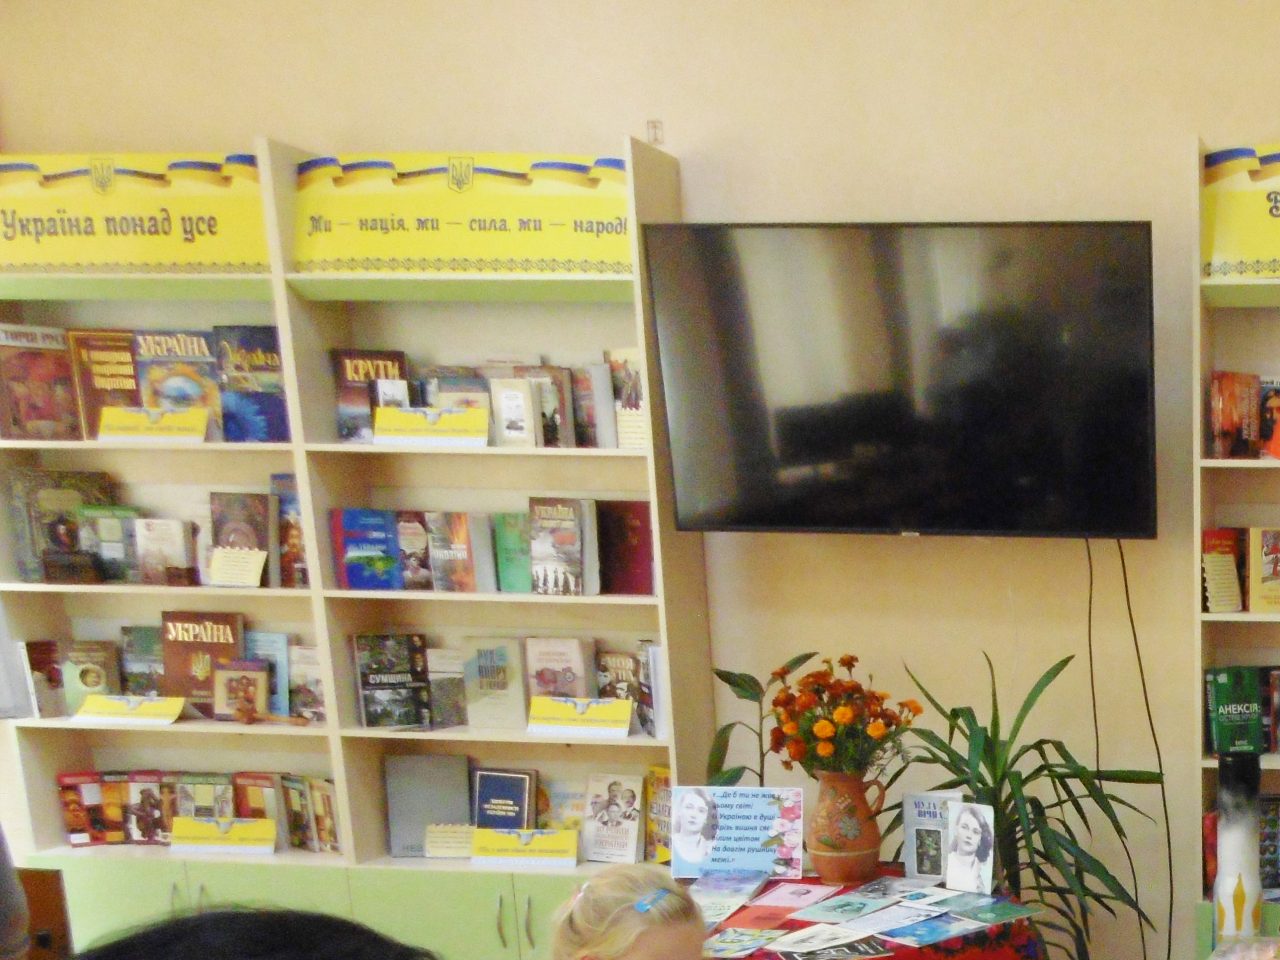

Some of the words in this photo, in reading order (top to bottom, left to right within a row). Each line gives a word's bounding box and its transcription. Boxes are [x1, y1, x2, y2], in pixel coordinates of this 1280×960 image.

[0, 207, 96, 244] Україна
[104, 207, 173, 237] понад
[180, 213, 219, 244] усе
[415, 216, 441, 232] ми
[517, 216, 543, 232] ми
[573, 214, 628, 238] народ!
[165, 621, 235, 644] УКРАЇНА
